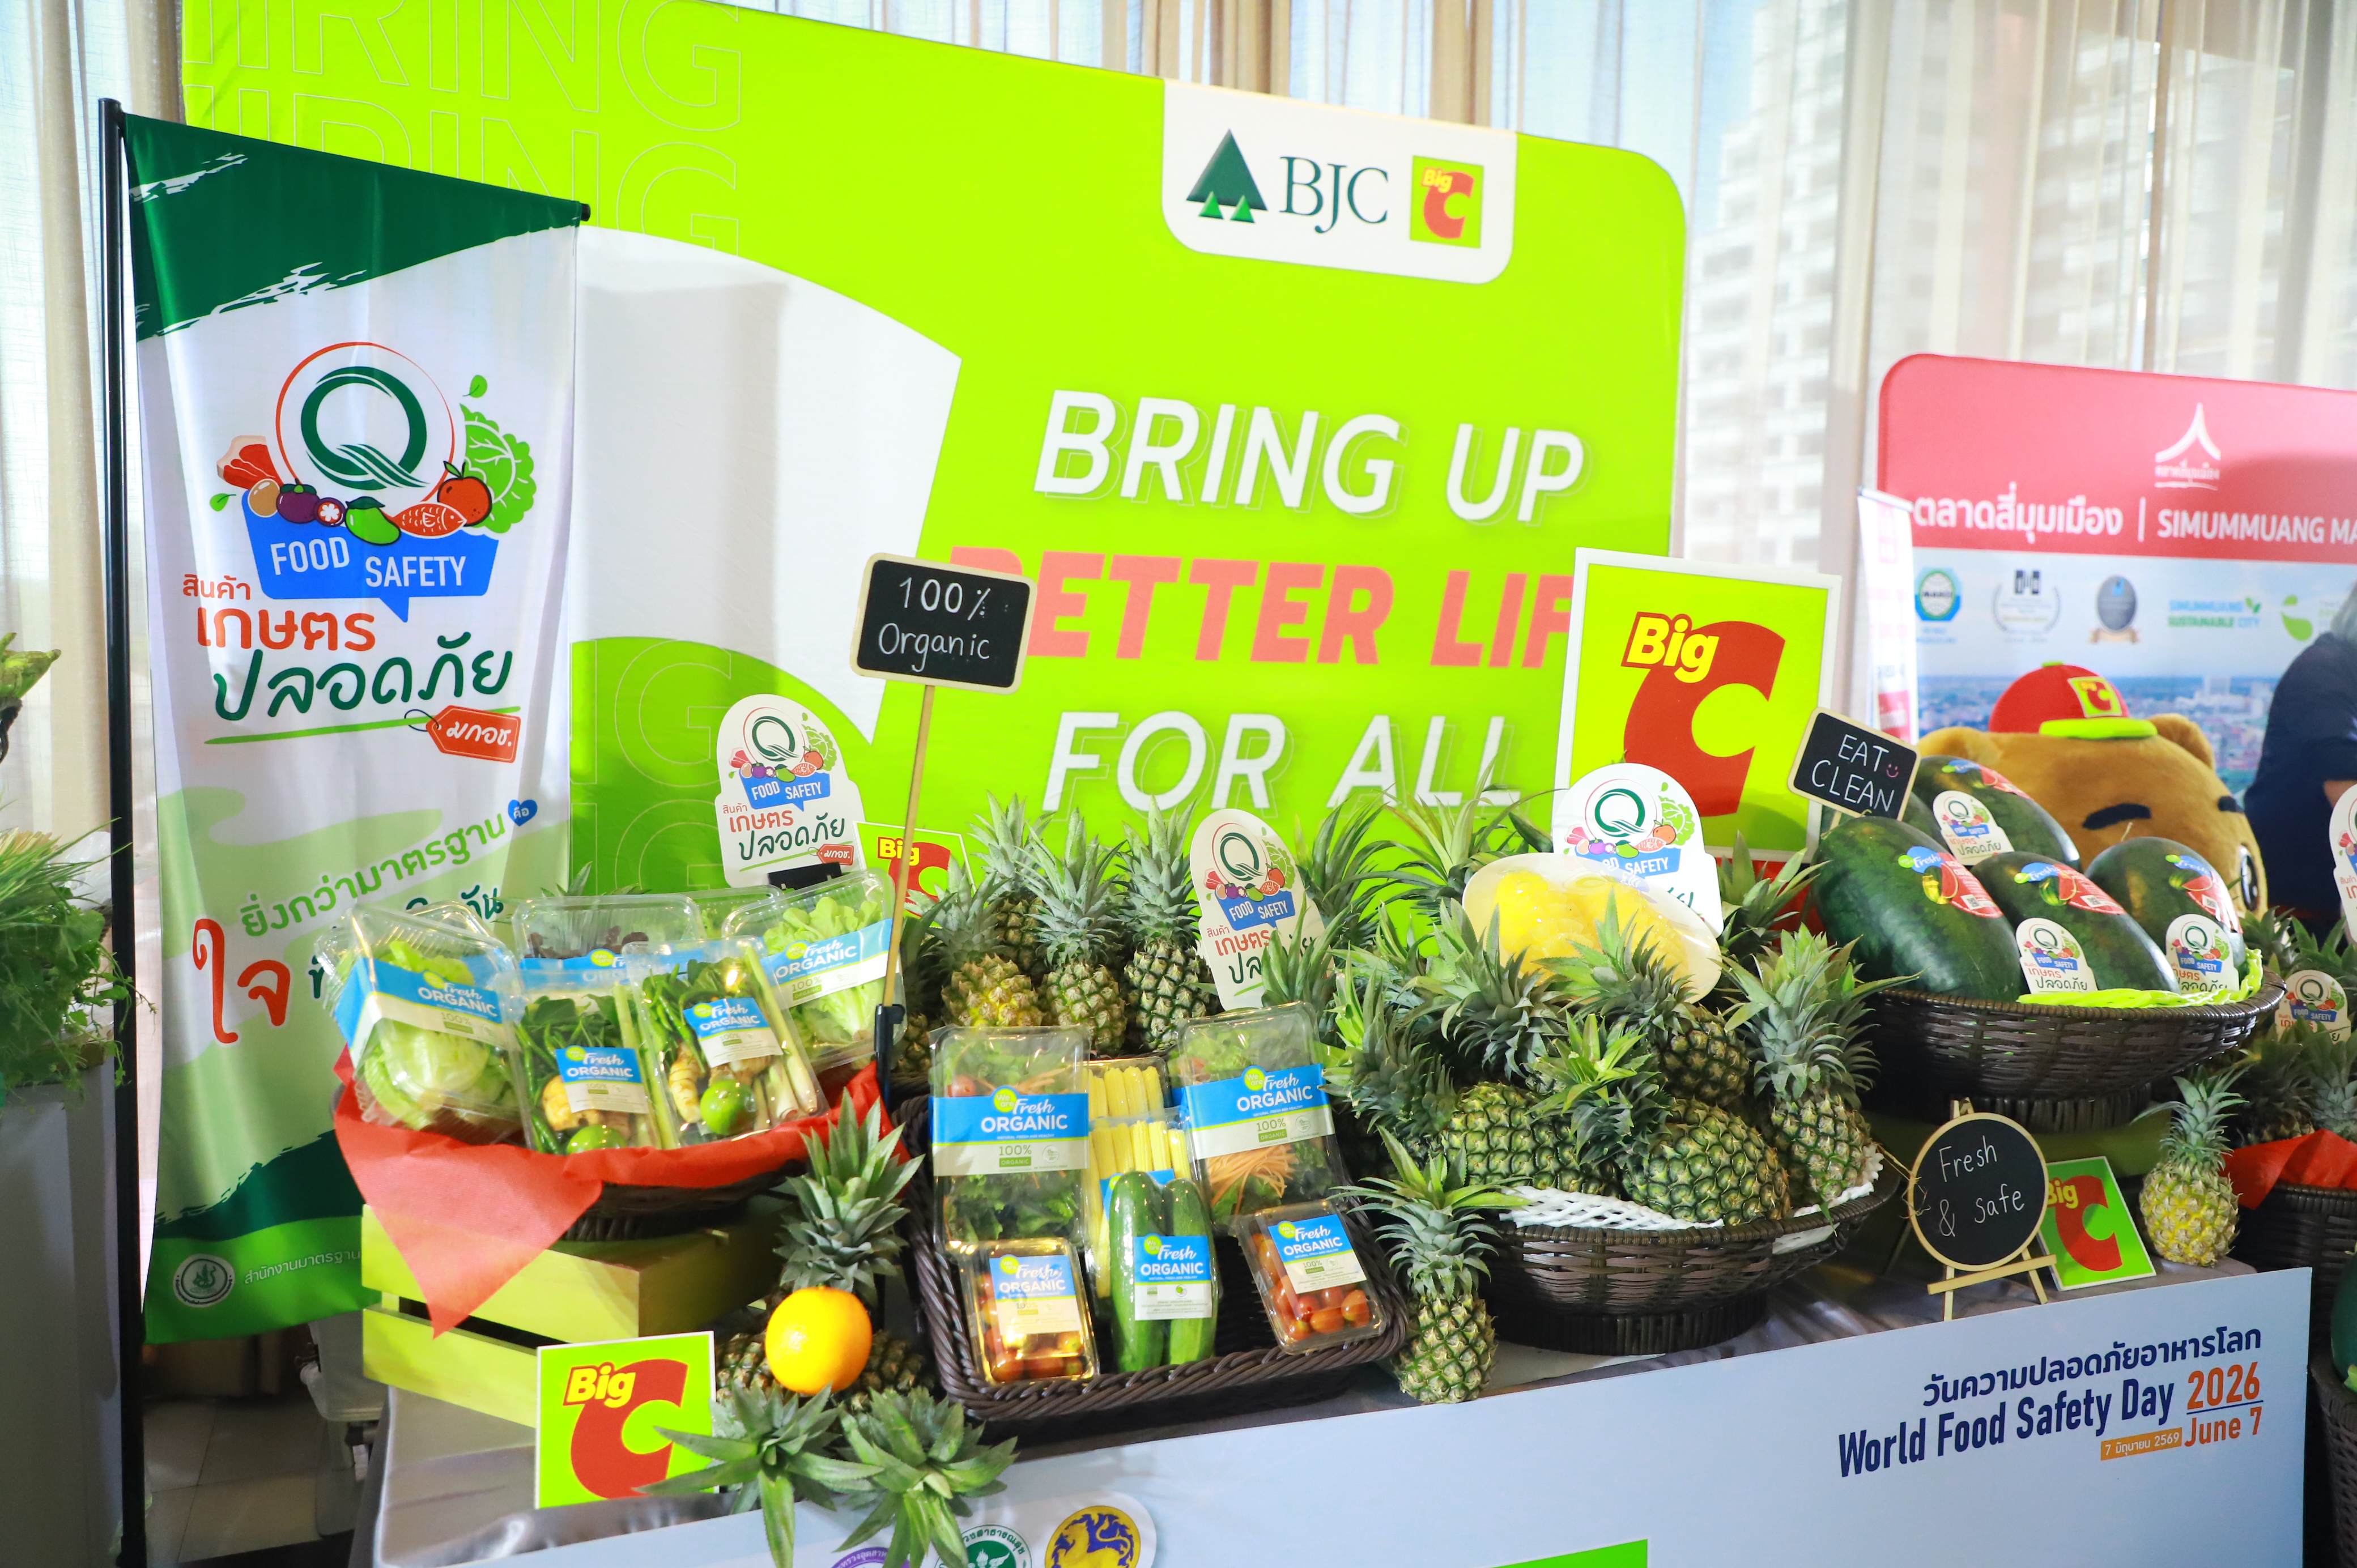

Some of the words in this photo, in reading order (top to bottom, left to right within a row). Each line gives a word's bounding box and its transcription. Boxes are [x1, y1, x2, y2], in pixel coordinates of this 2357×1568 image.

[1423, 167, 1453, 193] Big
[1279, 156, 1389, 233] BJC
[1423, 171, 1475, 240] C
[1033, 389, 1400, 514] BRING
[1446, 423, 1584, 522] UP
[1913, 480, 2124, 544] ตลาดสี่มุมเมือง
[2157, 508, 2325, 544] SIMUMMUANG
[270, 536, 350, 576] FOOD
[365, 555, 466, 589] SAFETY
[182, 573, 251, 601] สินค้า
[899, 577, 991, 621] 100%
[950, 546, 1394, 665] ETTER
[1429, 570, 1574, 668] LIF
[197, 607, 375, 651] เกษตร
[878, 623, 990, 672] Organic
[1627, 616, 1720, 684] Big
[213, 632, 513, 721] ปลอดภัย
[1623, 620, 1786, 817] C
[446, 721, 512, 747] มกอช.
[1042, 711, 1286, 812] FOR
[1327, 714, 1521, 809] ALL
[1838, 734, 1890, 772] EAT
[751, 781, 781, 801] FOOD
[785, 782, 822, 800] SAFETY
[1811, 760, 1895, 812] CLEAN
[513, 806, 530, 820] คือ
[723, 803, 748, 815] สินค้า
[729, 810, 794, 833] เกษตร
[739, 812, 845, 861] ปลอดภัย
[1957, 840, 2002, 856] ปลอดภัย
[824, 850, 850, 859] มกอช.
[879, 838, 920, 866] Big
[1913, 854, 1941, 868] Fresh
[240, 813, 506, 937] ยิ่งกว่ามาตรฐาน
[1624, 857, 1669, 876] SAFETY
[1229, 901, 1254, 922] FOOD
[1257, 900, 1289, 920] SAFETY
[1206, 925, 1231, 938] สินค้า
[1215, 930, 1271, 957] เกษตร
[775, 945, 857, 978] ORGANIC
[803, 939, 844, 958] Fresh
[2028, 968, 2062, 978] เกษตร
[2054, 960, 2074, 969] SAFETY
[2173, 968, 2200, 981] กษตร
[2197, 961, 2218, 971] SAFETY
[192, 918, 291, 1043] ใจ
[444, 982, 482, 1000] Fresh
[792, 975, 822, 992] 100%
[2035, 977, 2088, 991] ปลอดภัย
[418, 986, 498, 1017] ORGANIC
[712, 1004, 748, 1019] Fresh
[699, 1015, 760, 1031] ORGANIC
[567, 1066, 634, 1077] ORGANIC
[582, 1053, 625, 1066] Fresh
[1262, 1073, 1299, 1092] Fresh
[1012, 1098, 1055, 1115] Fresh
[1237, 1085, 1313, 1111] ORGANIC
[981, 1114, 1069, 1132] ORGANIC
[1256, 1118, 1286, 1132] 100%
[1260, 1131, 1285, 1140] ORGANIC
[999, 1145, 1032, 1156] 100%
[1938, 1135, 1998, 1183] Fresh
[1939, 1199, 1956, 1237] &
[2056, 1174, 2123, 1272] C
[1283, 1237, 1343, 1256] ORGANIC
[1295, 1225, 1331, 1242] Fresh
[1157, 1245, 1197, 1261] Fresh
[244, 1250, 361, 1285] สำนักงานมาตรฐาน
[1015, 1264, 1058, 1280] Fresh
[1141, 1262, 1204, 1276] ORGANIC
[999, 1279, 1066, 1293] ORGANIC
[1922, 1326, 2261, 1407] วันความปลอดภัยอาหารโลก
[567, 1366, 636, 1408] Big
[571, 1358, 688, 1499] C
[1839, 1418, 1926, 1477] World
[1937, 1401, 2006, 1456] Food
[2016, 1387, 2112, 1439] Safety
[2121, 1378, 2175, 1425] Day
[2186, 1361, 2261, 1411] 2026
[2184, 1411, 2241, 1447] June
[2252, 1407, 2263, 1436] 7
[2104, 1444, 2111, 1456] 7
[2115, 1435, 2151, 1456] มิถุนายน
[2154, 1432, 2180, 1448] 2569
